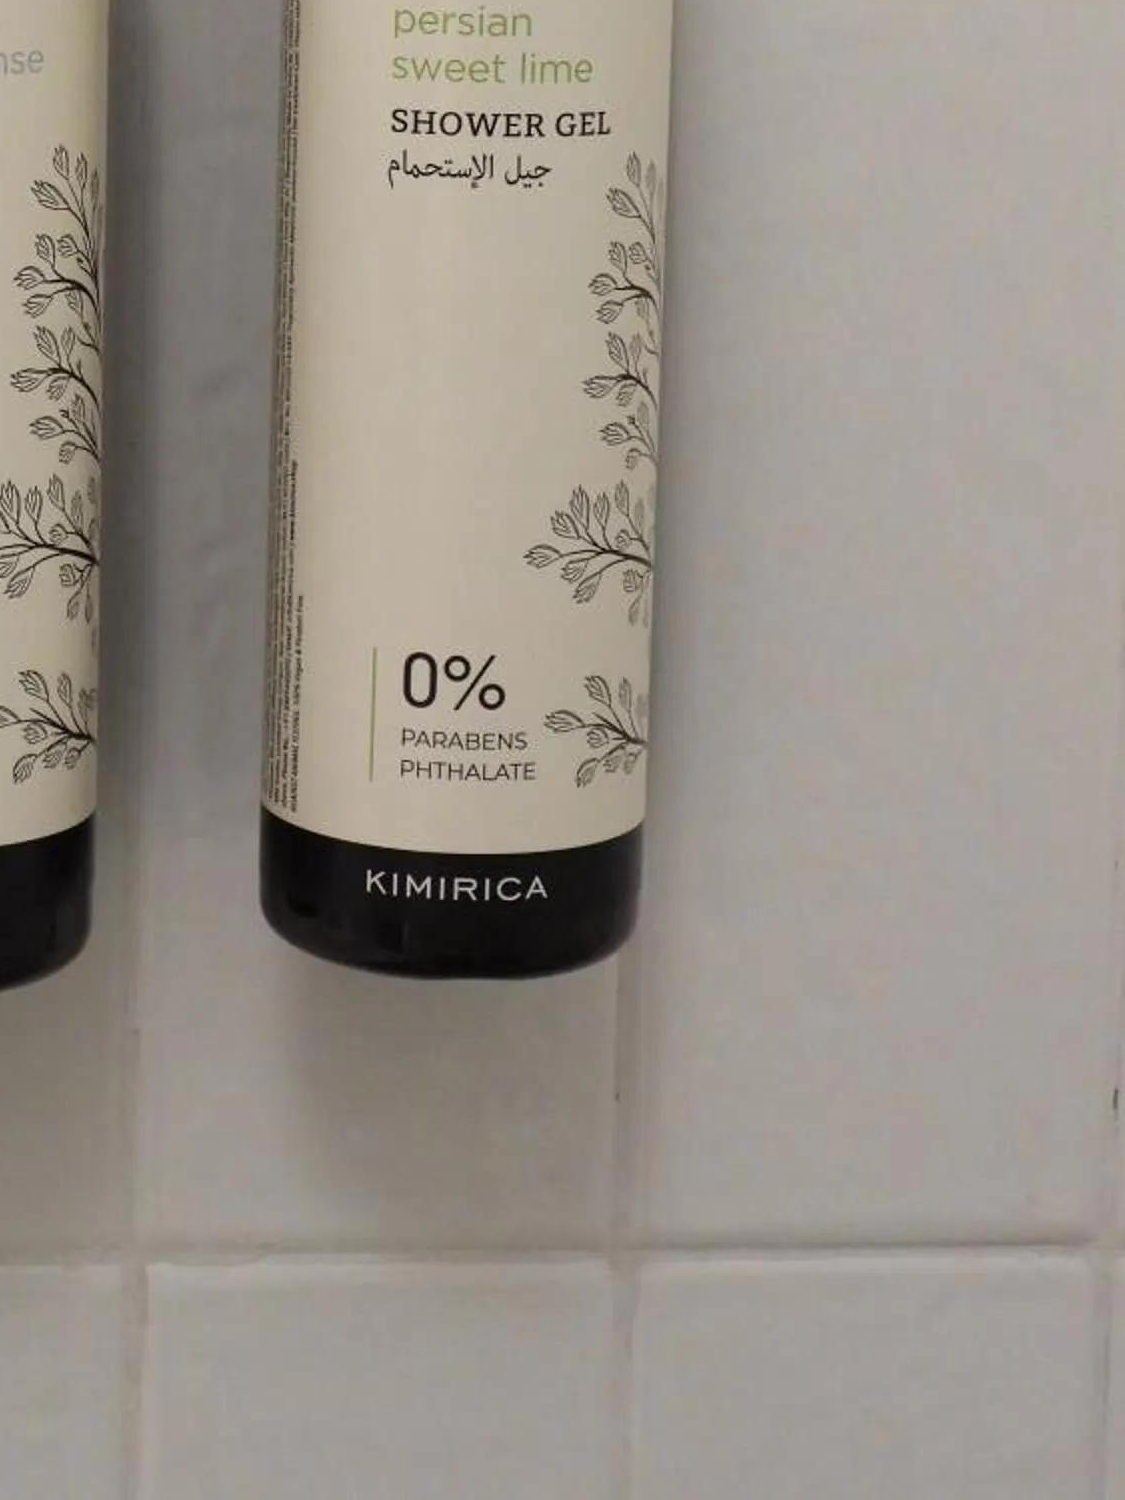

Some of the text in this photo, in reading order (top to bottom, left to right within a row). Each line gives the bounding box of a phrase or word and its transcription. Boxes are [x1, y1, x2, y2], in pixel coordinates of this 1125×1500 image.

[394, 5, 532, 40] persian
[392, 52, 594, 85] sweet lime
[391, 108, 611, 138] SHOWER GEL
[504, 155, 552, 188] جيل
[403, 651, 506, 711] 0%
[401, 727, 528, 751] PARABENS
[400, 759, 536, 782] PHTHALATE
[366, 869, 548, 901] KIMIRICA
